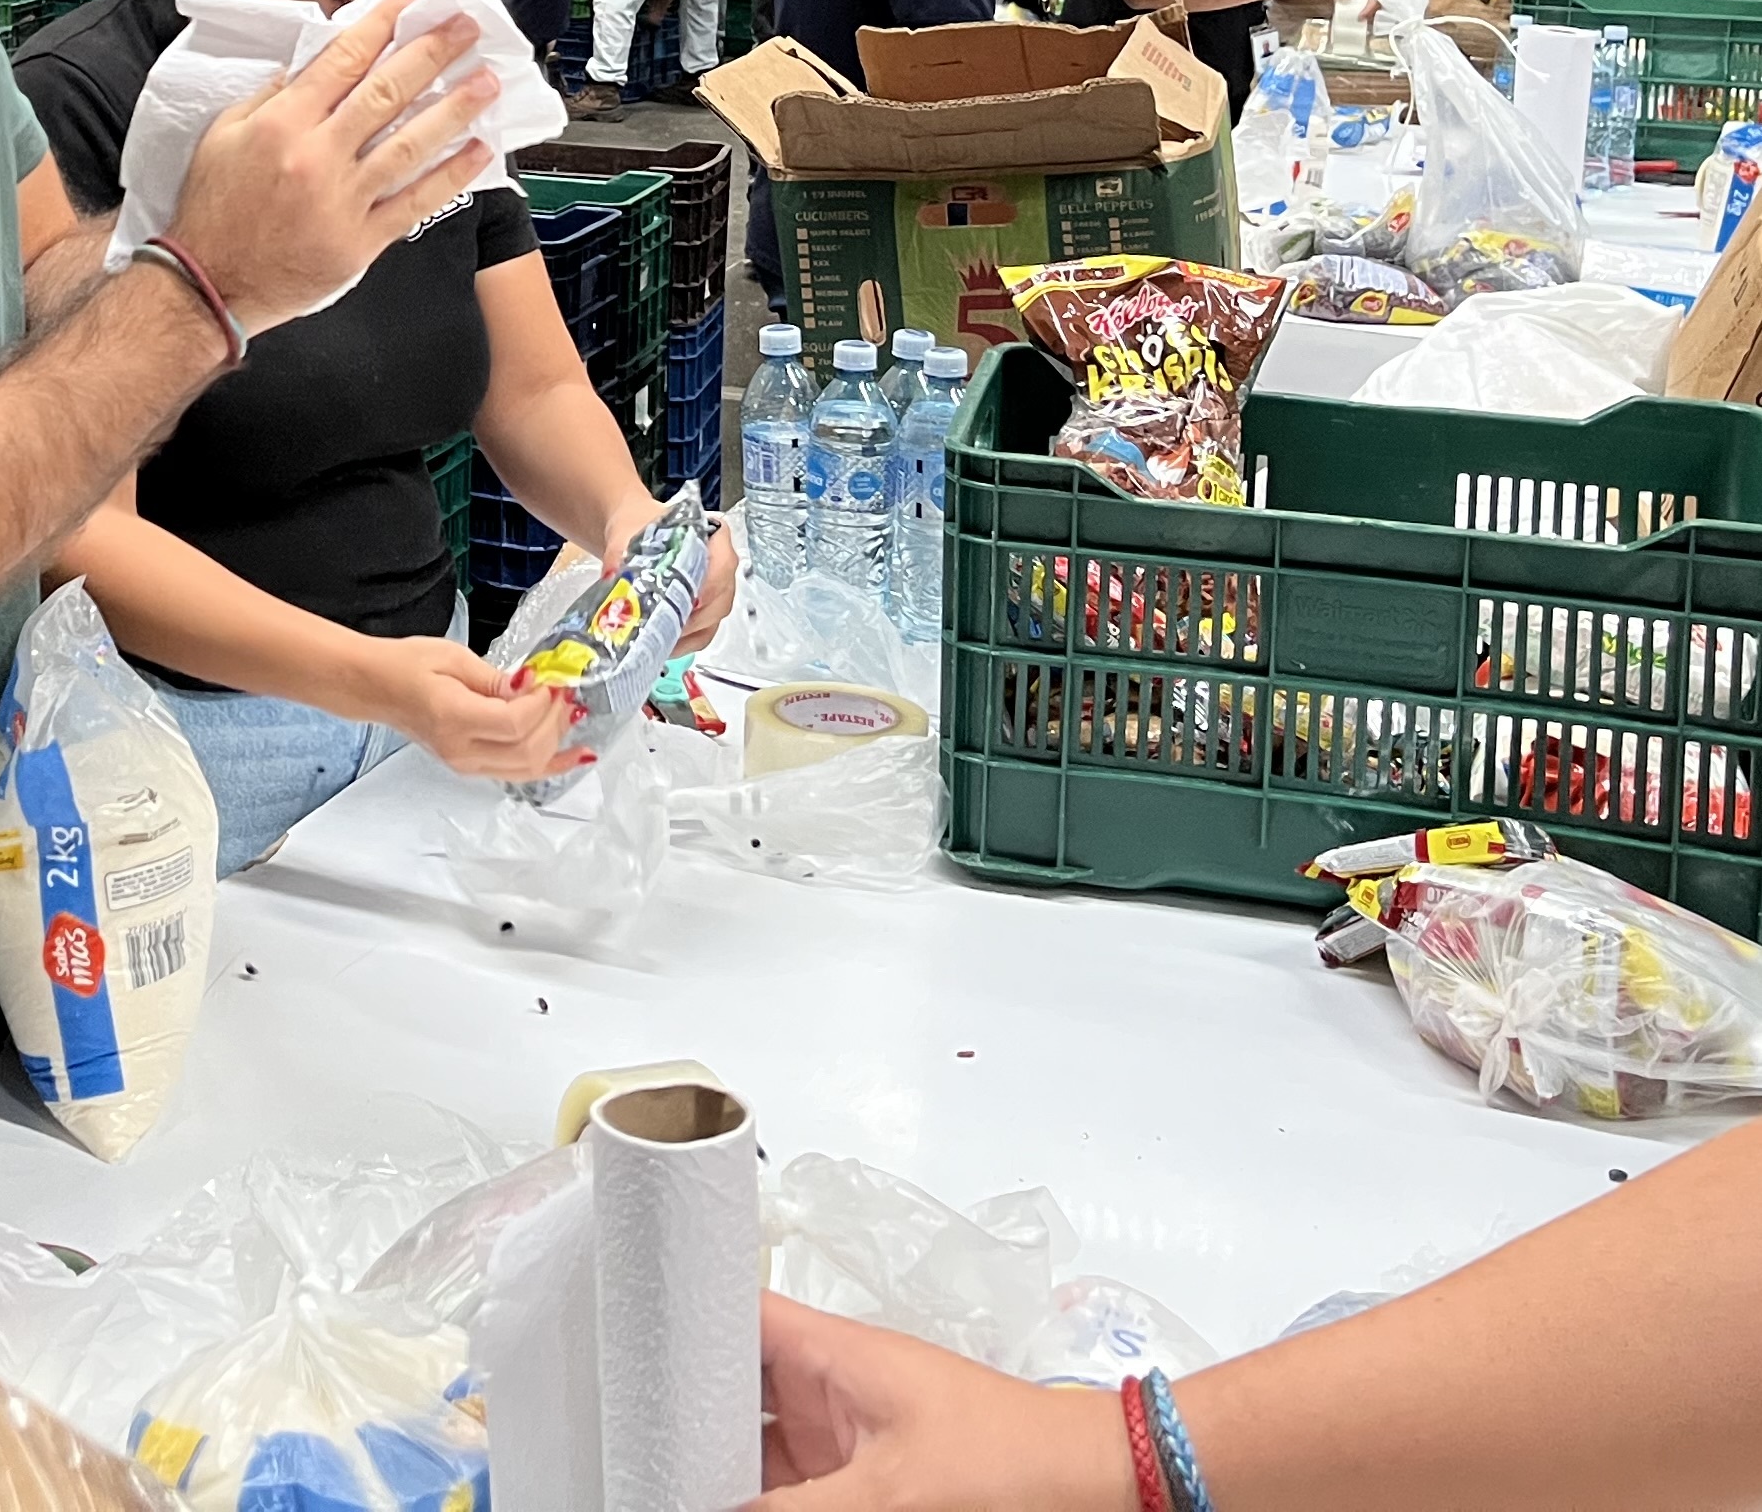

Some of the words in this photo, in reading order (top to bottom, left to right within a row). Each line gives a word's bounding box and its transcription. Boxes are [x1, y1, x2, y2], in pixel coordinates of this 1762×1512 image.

[1059, 203, 1091, 215] BELL
[1094, 198, 1155, 213] PEPPERS
[794, 210, 870, 223] CUCUMBERS
[820, 712, 875, 728] BESTAPE
